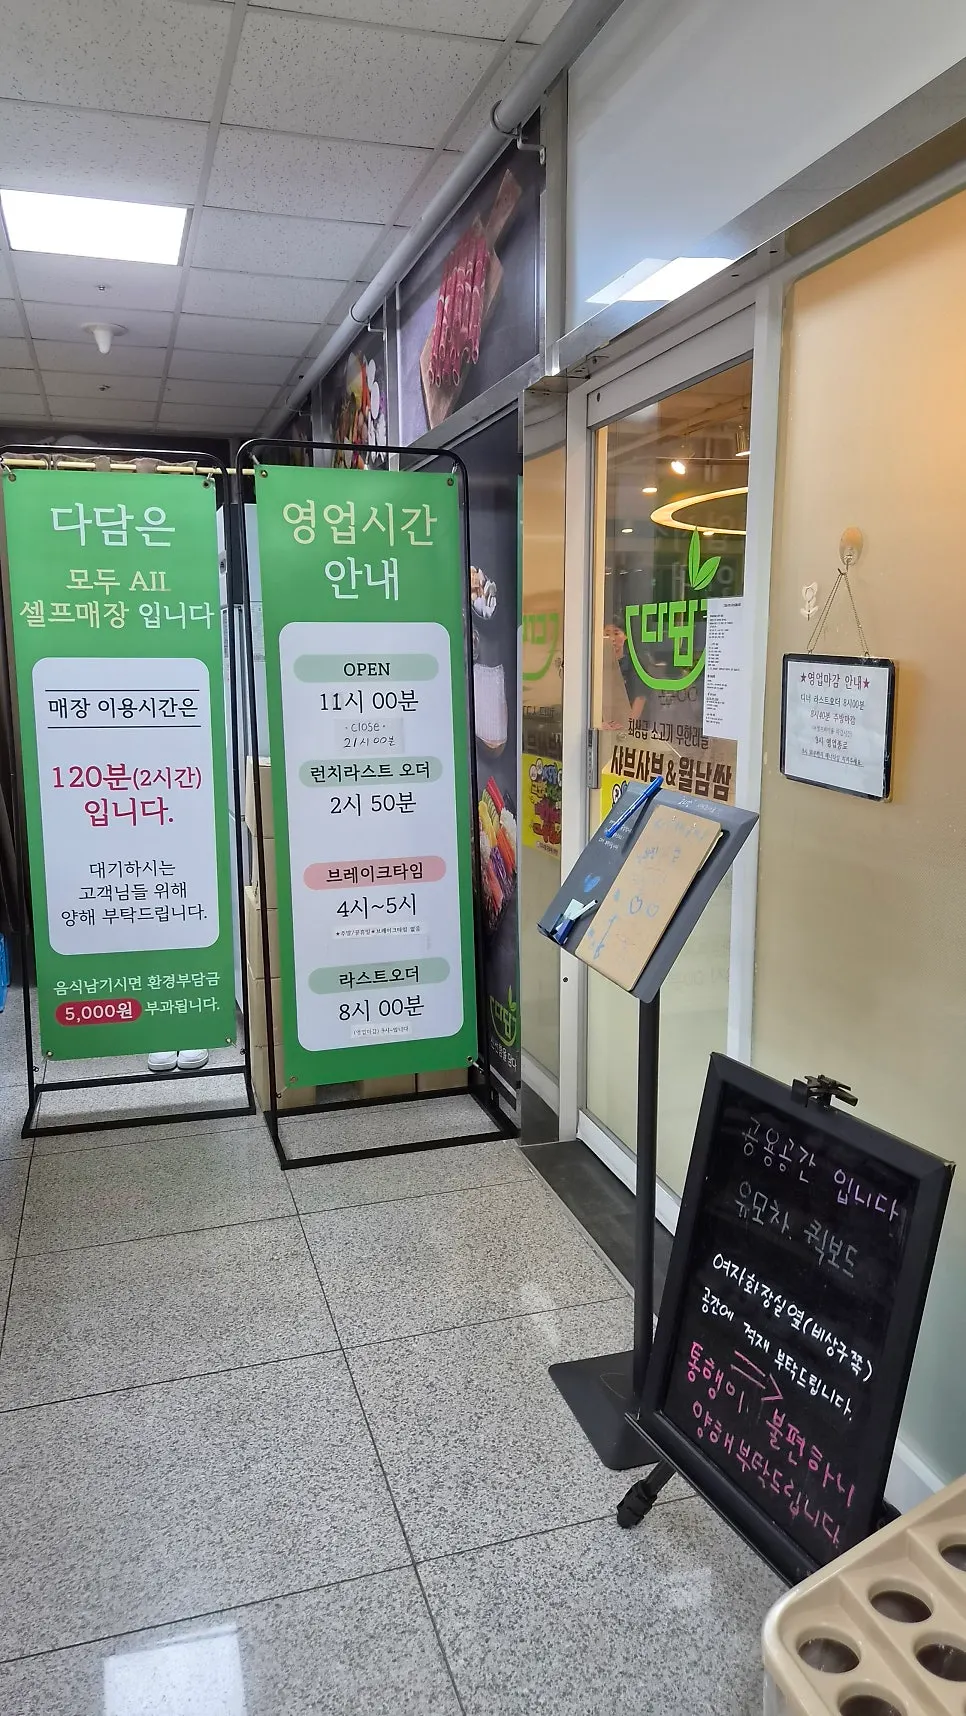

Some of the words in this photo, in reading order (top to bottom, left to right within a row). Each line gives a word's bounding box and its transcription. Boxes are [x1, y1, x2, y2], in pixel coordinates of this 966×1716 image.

[51, 503, 175, 546] 다담은
[283, 500, 437, 546] 영업시간
[66, 569, 120, 595] 모두
[325, 557, 398, 601] 안내
[20, 600, 129, 629] 셀프매장
[139, 602, 215, 629] 입니다
[344, 663, 390, 676] OPEN
[807, 672, 840, 688] 영업마감
[845, 675, 861, 690] 안내
[49, 698, 90, 718] 매장
[98, 698, 198, 718] 이용시간은
[320, 690, 363, 713] 11시
[373, 690, 418, 712] 00분
[651, 721, 673, 743] 소고기
[53, 764, 202, 791] 120분(2시간)
[310, 763, 393, 783] 런치라스트
[399, 760, 430, 778] 오더
[666, 760, 677, 786] &
[679, 757, 732, 801] 월남쌈
[84, 797, 173, 826] 입니다.
[330, 793, 361, 816] 2시
[371, 792, 417, 814] 50분
[89, 860, 175, 878] 대기하시는
[326, 862, 424, 884] 브레이크타임
[79, 883, 148, 901] 고객님들
[154, 882, 187, 899] 위해
[61, 909, 95, 926] 양해
[102, 904, 207, 924] 부탁드립니다.
[336, 893, 417, 918] 4시~5시
[54, 976, 142, 996] 음식남기시면
[147, 972, 220, 990] 환경부담금
[339, 965, 419, 988] 라스트오더
[65, 1001, 133, 1023] 5,000원
[145, 997, 220, 1015] 부과됩니다.
[339, 1000, 370, 1021] 8시
[379, 995, 424, 1017] 00분
[742, 1117, 816, 1183] 공용공간
[702, 1287, 734, 1321] 공간에
[743, 1322, 770, 1353] 적재
[766, 1408, 855, 1507] 불편하니
